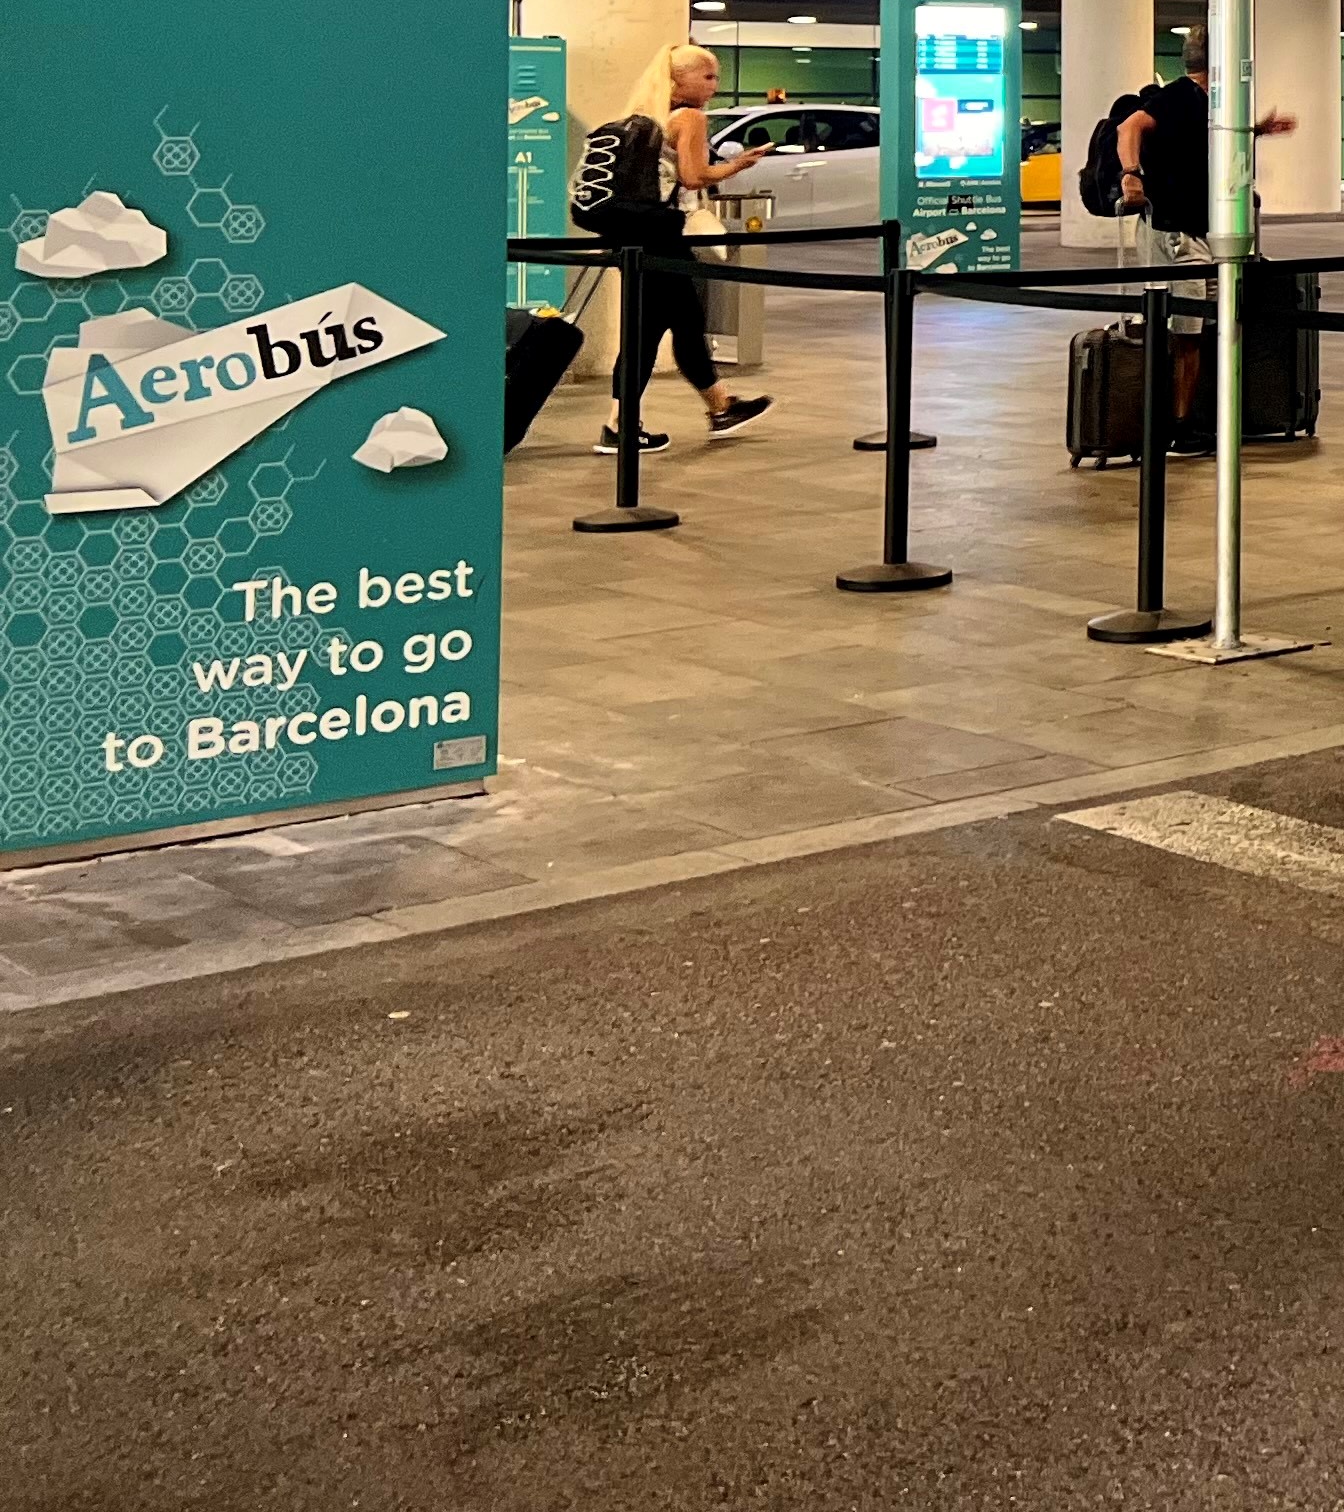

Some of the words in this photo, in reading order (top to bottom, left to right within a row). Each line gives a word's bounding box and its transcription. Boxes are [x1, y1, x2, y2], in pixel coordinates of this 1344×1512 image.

[912, 207, 946, 218] Airport
[961, 206, 1006, 215] Barcelona
[67, 312, 385, 444] Aerobús
[233, 578, 338, 623] The
[358, 560, 474, 609] best
[192, 646, 308, 694] way
[329, 635, 385, 676] to
[404, 628, 473, 673] go
[102, 730, 163, 773] to
[187, 691, 472, 761] Barcelona
